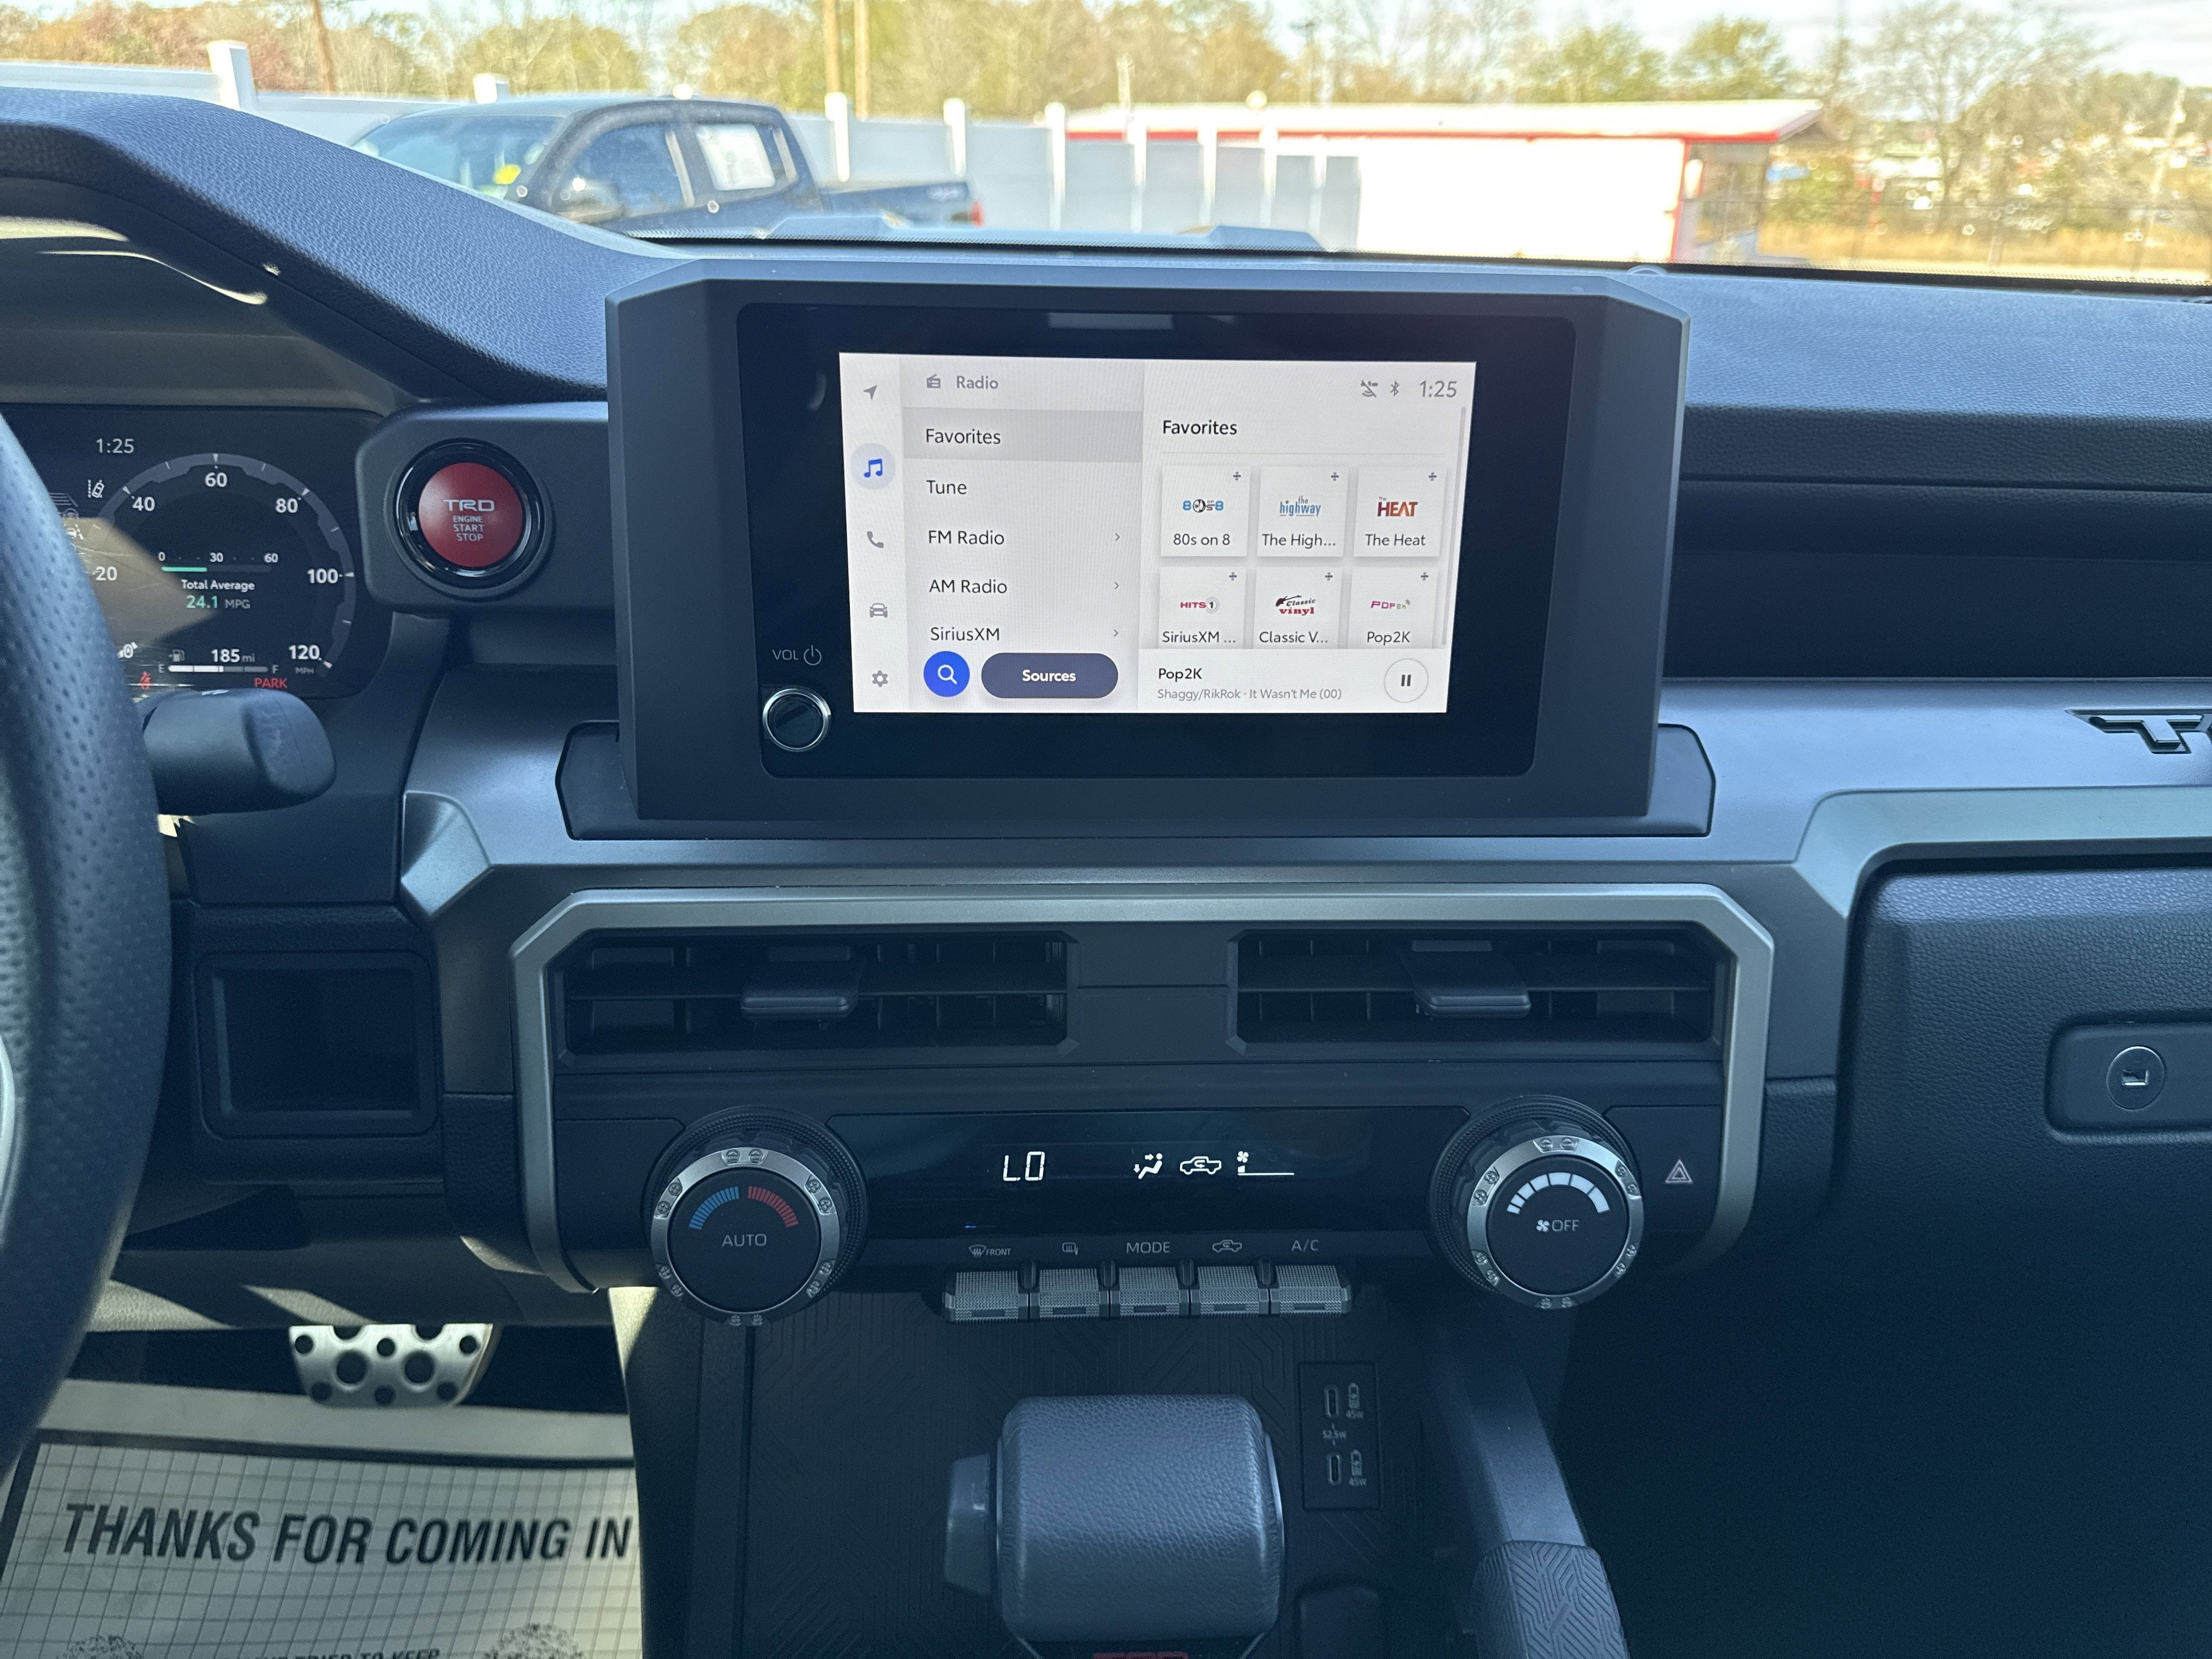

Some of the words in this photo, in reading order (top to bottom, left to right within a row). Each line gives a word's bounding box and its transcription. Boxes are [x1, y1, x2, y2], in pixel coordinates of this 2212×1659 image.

[956, 375, 998, 390] Radio
[1419, 381, 1457, 398] 1:25
[1162, 420, 1238, 436] Favorites
[926, 428, 1001, 445] Favorites
[96, 438, 134, 454] 1:25
[205, 473, 227, 487] 60
[926, 479, 967, 495] Tune
[132, 496, 155, 511] 40
[275, 498, 298, 513] 80
[442, 499, 494, 511] TRD
[1298, 495, 1309, 504] the
[1279, 500, 1321, 517] highway
[1378, 501, 1418, 516] HEAT
[453, 524, 484, 532] START
[456, 533, 483, 541] STOP
[928, 531, 952, 544] FM
[957, 530, 1005, 545] Radio
[1173, 534, 1197, 545] 80s
[1200, 537, 1218, 545] on
[1222, 534, 1230, 545] 8
[1262, 533, 1286, 546] The
[1291, 533, 1336, 549] High...
[1365, 534, 1390, 546] The
[1394, 534, 1426, 546] Heat
[158, 552, 166, 561] 0
[210, 552, 224, 562] 30
[264, 553, 279, 563] 60
[95, 566, 117, 581] 20
[307, 569, 338, 584] 100
[181, 579, 208, 590] Total
[210, 580, 255, 592] Average
[929, 579, 955, 593] AM
[961, 579, 1007, 594] Radio
[186, 595, 218, 608] 24.1
[225, 599, 251, 609] MPG
[1286, 597, 1316, 607] Classic
[1279, 607, 1315, 616] vinyl
[930, 627, 1000, 641] SiriusXM
[1162, 631, 1219, 642] SiriusXM
[1259, 631, 1305, 643] Classic
[1367, 631, 1410, 646] Pop2K
[211, 649, 240, 663] 185
[241, 653, 255, 663] mi
[289, 645, 319, 660] 120
[772, 650, 799, 660] VOL
[158, 664, 164, 673] E
[272, 665, 279, 674] F
[1022, 669, 1076, 682] Sources
[1159, 668, 1202, 682] Pop2K
[254, 678, 287, 689] PARK
[1158, 689, 1240, 701] Shaggy/RikRok
[1250, 689, 1257, 698] It
[1260, 689, 1297, 698] Wasn't
[1300, 689, 1317, 698] Me
[1320, 689, 1342, 699] (00)
[1552, 1220, 1579, 1232] OFF
[722, 1233, 767, 1247] AUTO
[1291, 1239, 1319, 1252] A/C
[986, 1247, 1011, 1256] FRONT
[1126, 1242, 1170, 1254] MODE
[62, 1502, 260, 1562] THANKS
[273, 1514, 371, 1564] FOR
[386, 1517, 571, 1564] COMING
[584, 1515, 632, 1559] IN
